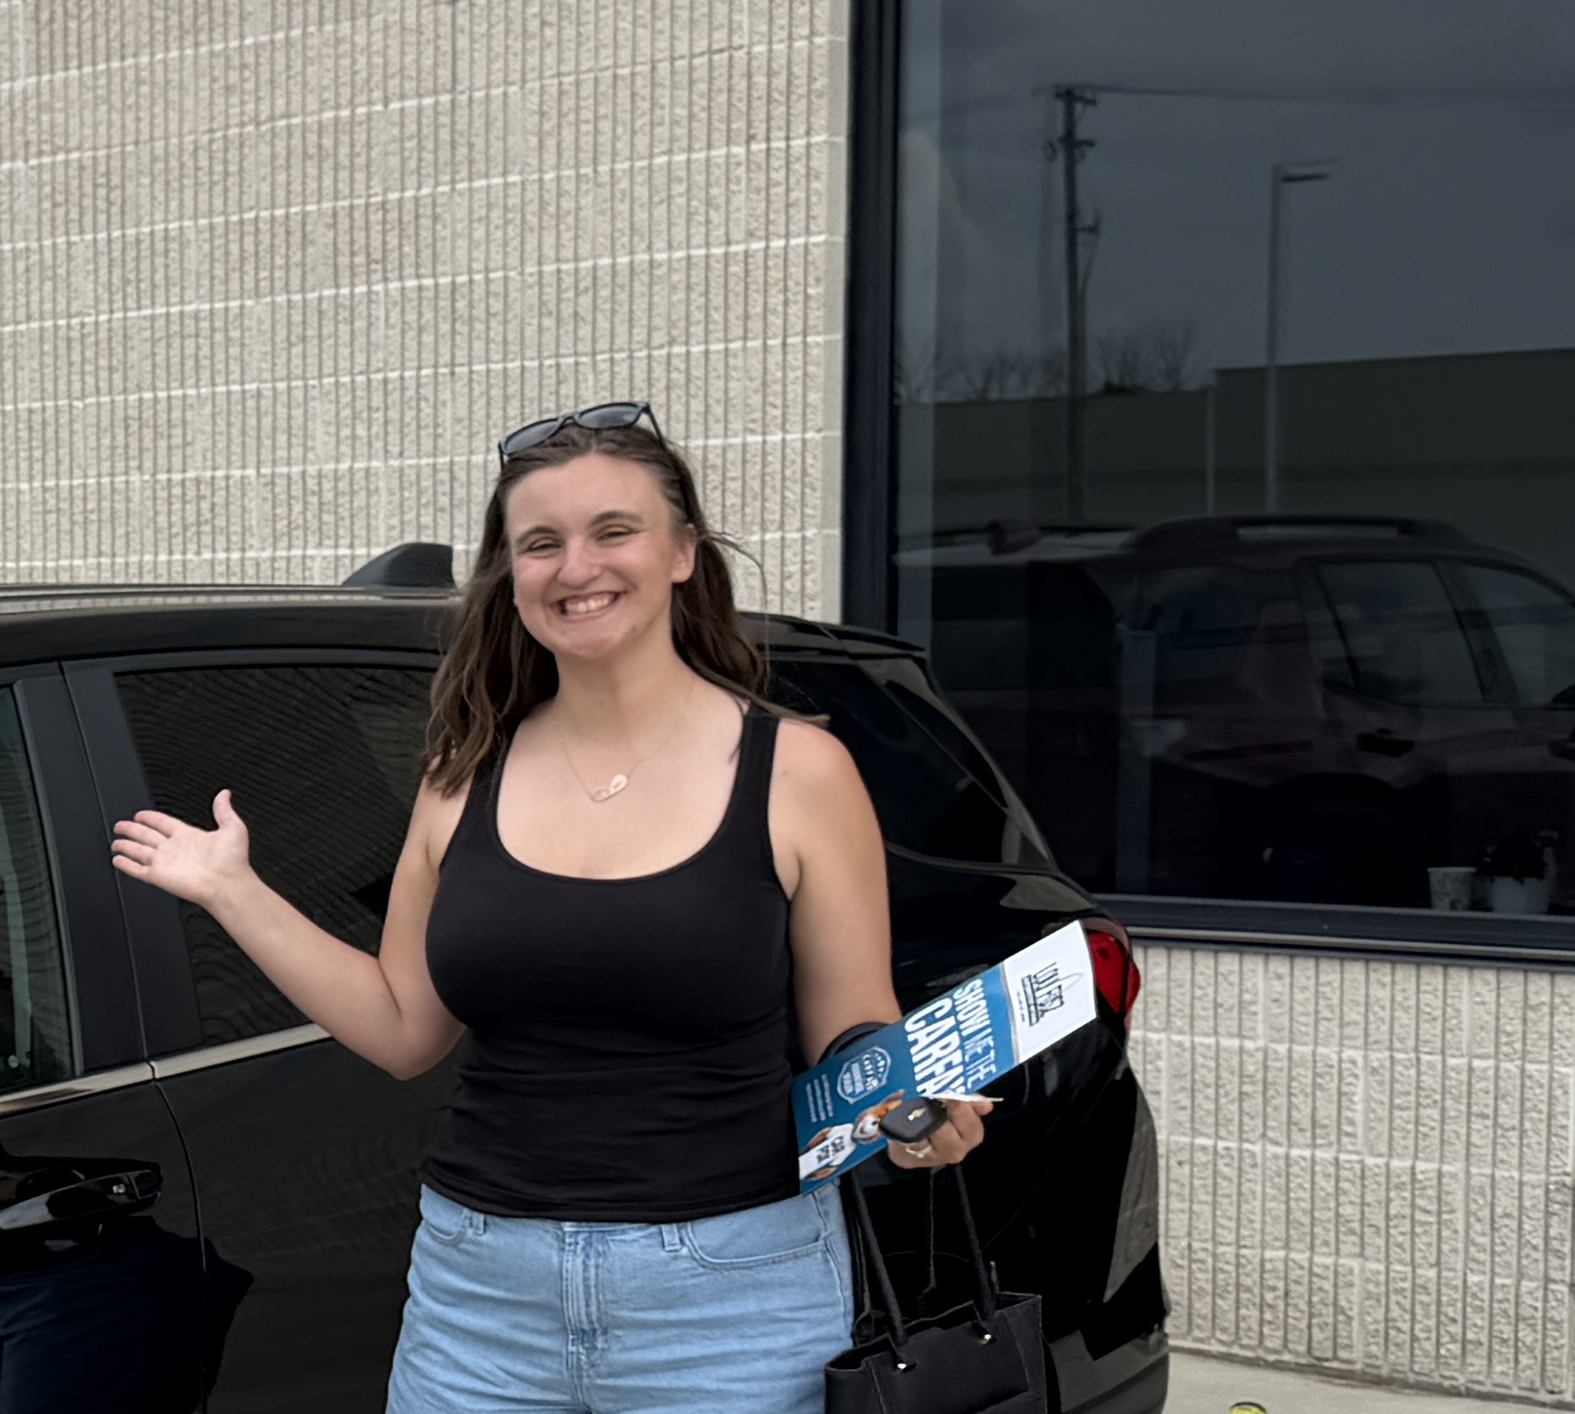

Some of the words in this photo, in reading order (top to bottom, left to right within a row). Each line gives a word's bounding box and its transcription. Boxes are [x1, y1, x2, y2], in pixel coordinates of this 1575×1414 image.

[952, 977, 990, 1037] SHOW
[962, 1026, 994, 1063] ME
[964, 1048, 997, 1089] THE
